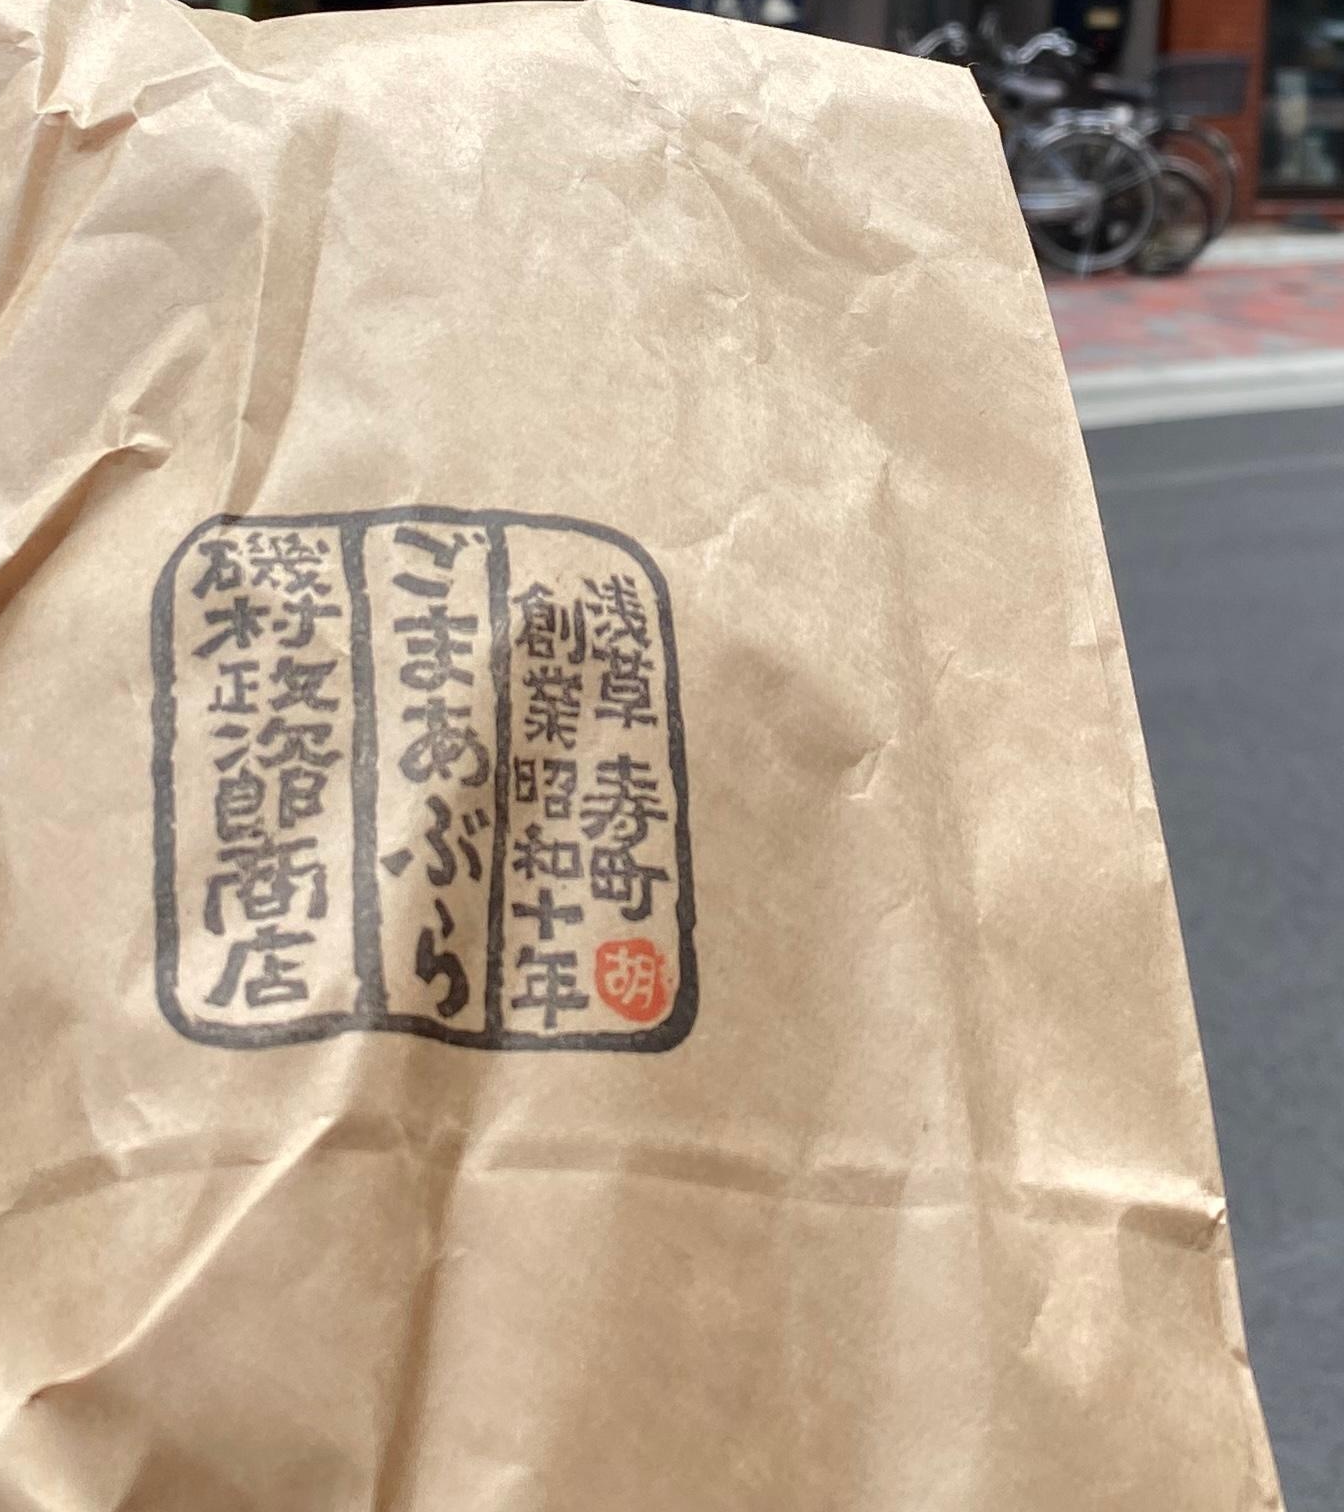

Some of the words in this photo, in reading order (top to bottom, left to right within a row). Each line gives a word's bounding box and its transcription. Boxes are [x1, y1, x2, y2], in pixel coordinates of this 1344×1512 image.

[191, 532, 343, 1009] 磯村政次郎商店
[380, 526, 490, 1018] ごまあぶら
[584, 573, 658, 730] 浅草
[511, 586, 591, 1029] 創業昭和十年
[581, 753, 670, 922] 寿町
[600, 942, 659, 1013] 胡
